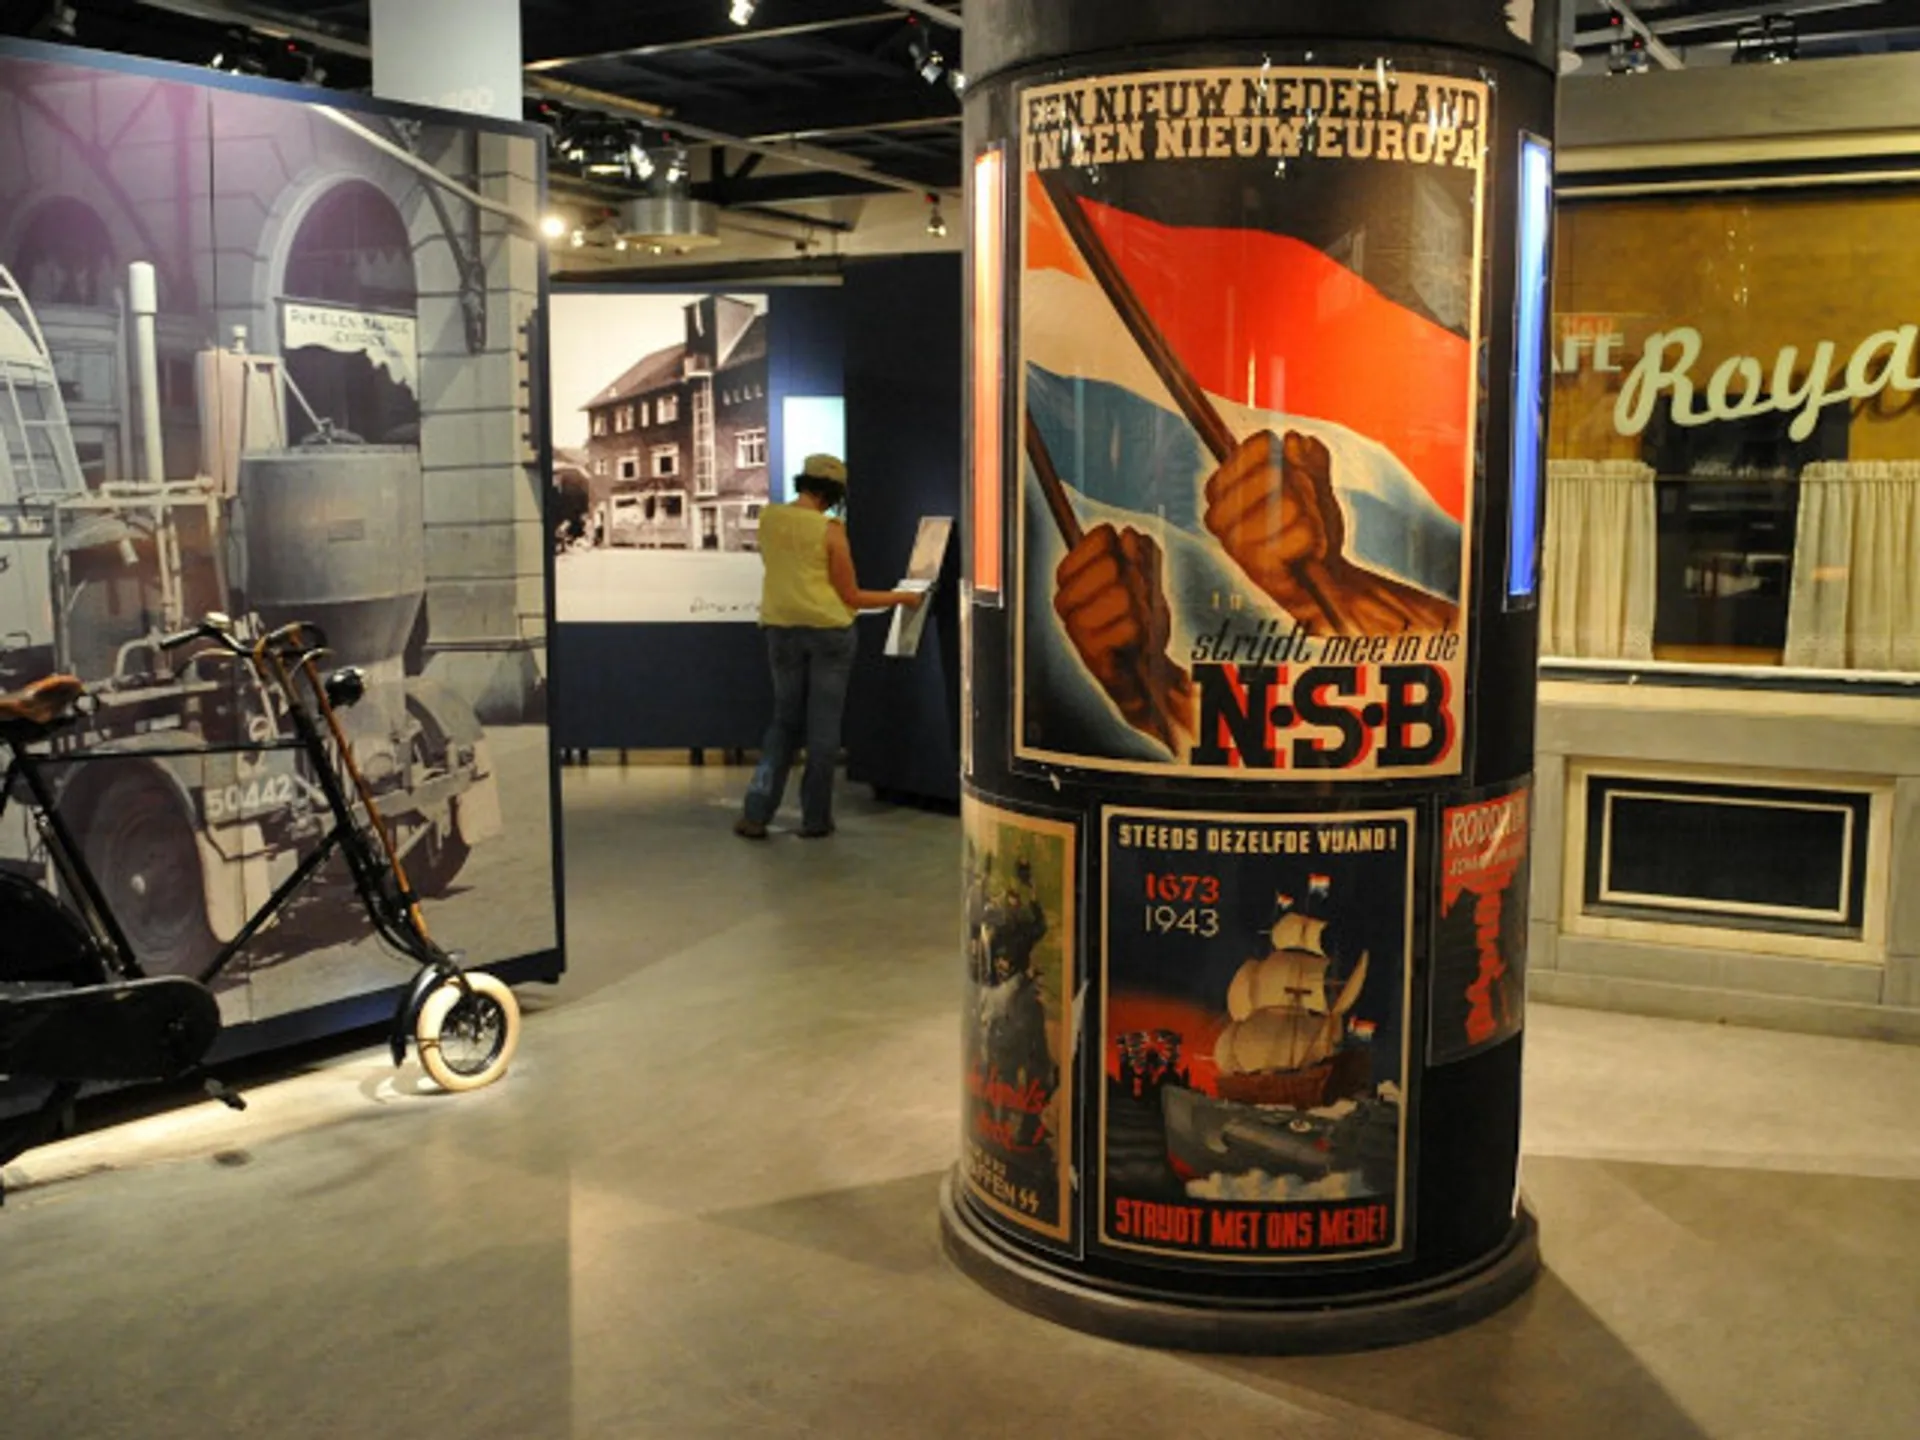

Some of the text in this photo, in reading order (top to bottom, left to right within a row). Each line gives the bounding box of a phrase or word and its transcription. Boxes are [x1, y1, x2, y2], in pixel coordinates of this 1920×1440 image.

[1028, 77, 1480, 134] EEN NIEUW NEDERLAND
[1024, 117, 1479, 170] IN EEN NIEUW EUROPA
[1190, 617, 1460, 670] strijdt mee in de
[205, 774, 292, 818] 50442
[1119, 823, 1199, 850] STEEDS
[1207, 829, 1310, 854] DEZELFDE
[1145, 872, 1221, 905] 1673
[1145, 905, 1220, 938] 1943
[1210, 1209, 1262, 1249] MET
[1266, 1210, 1314, 1249] ONS
